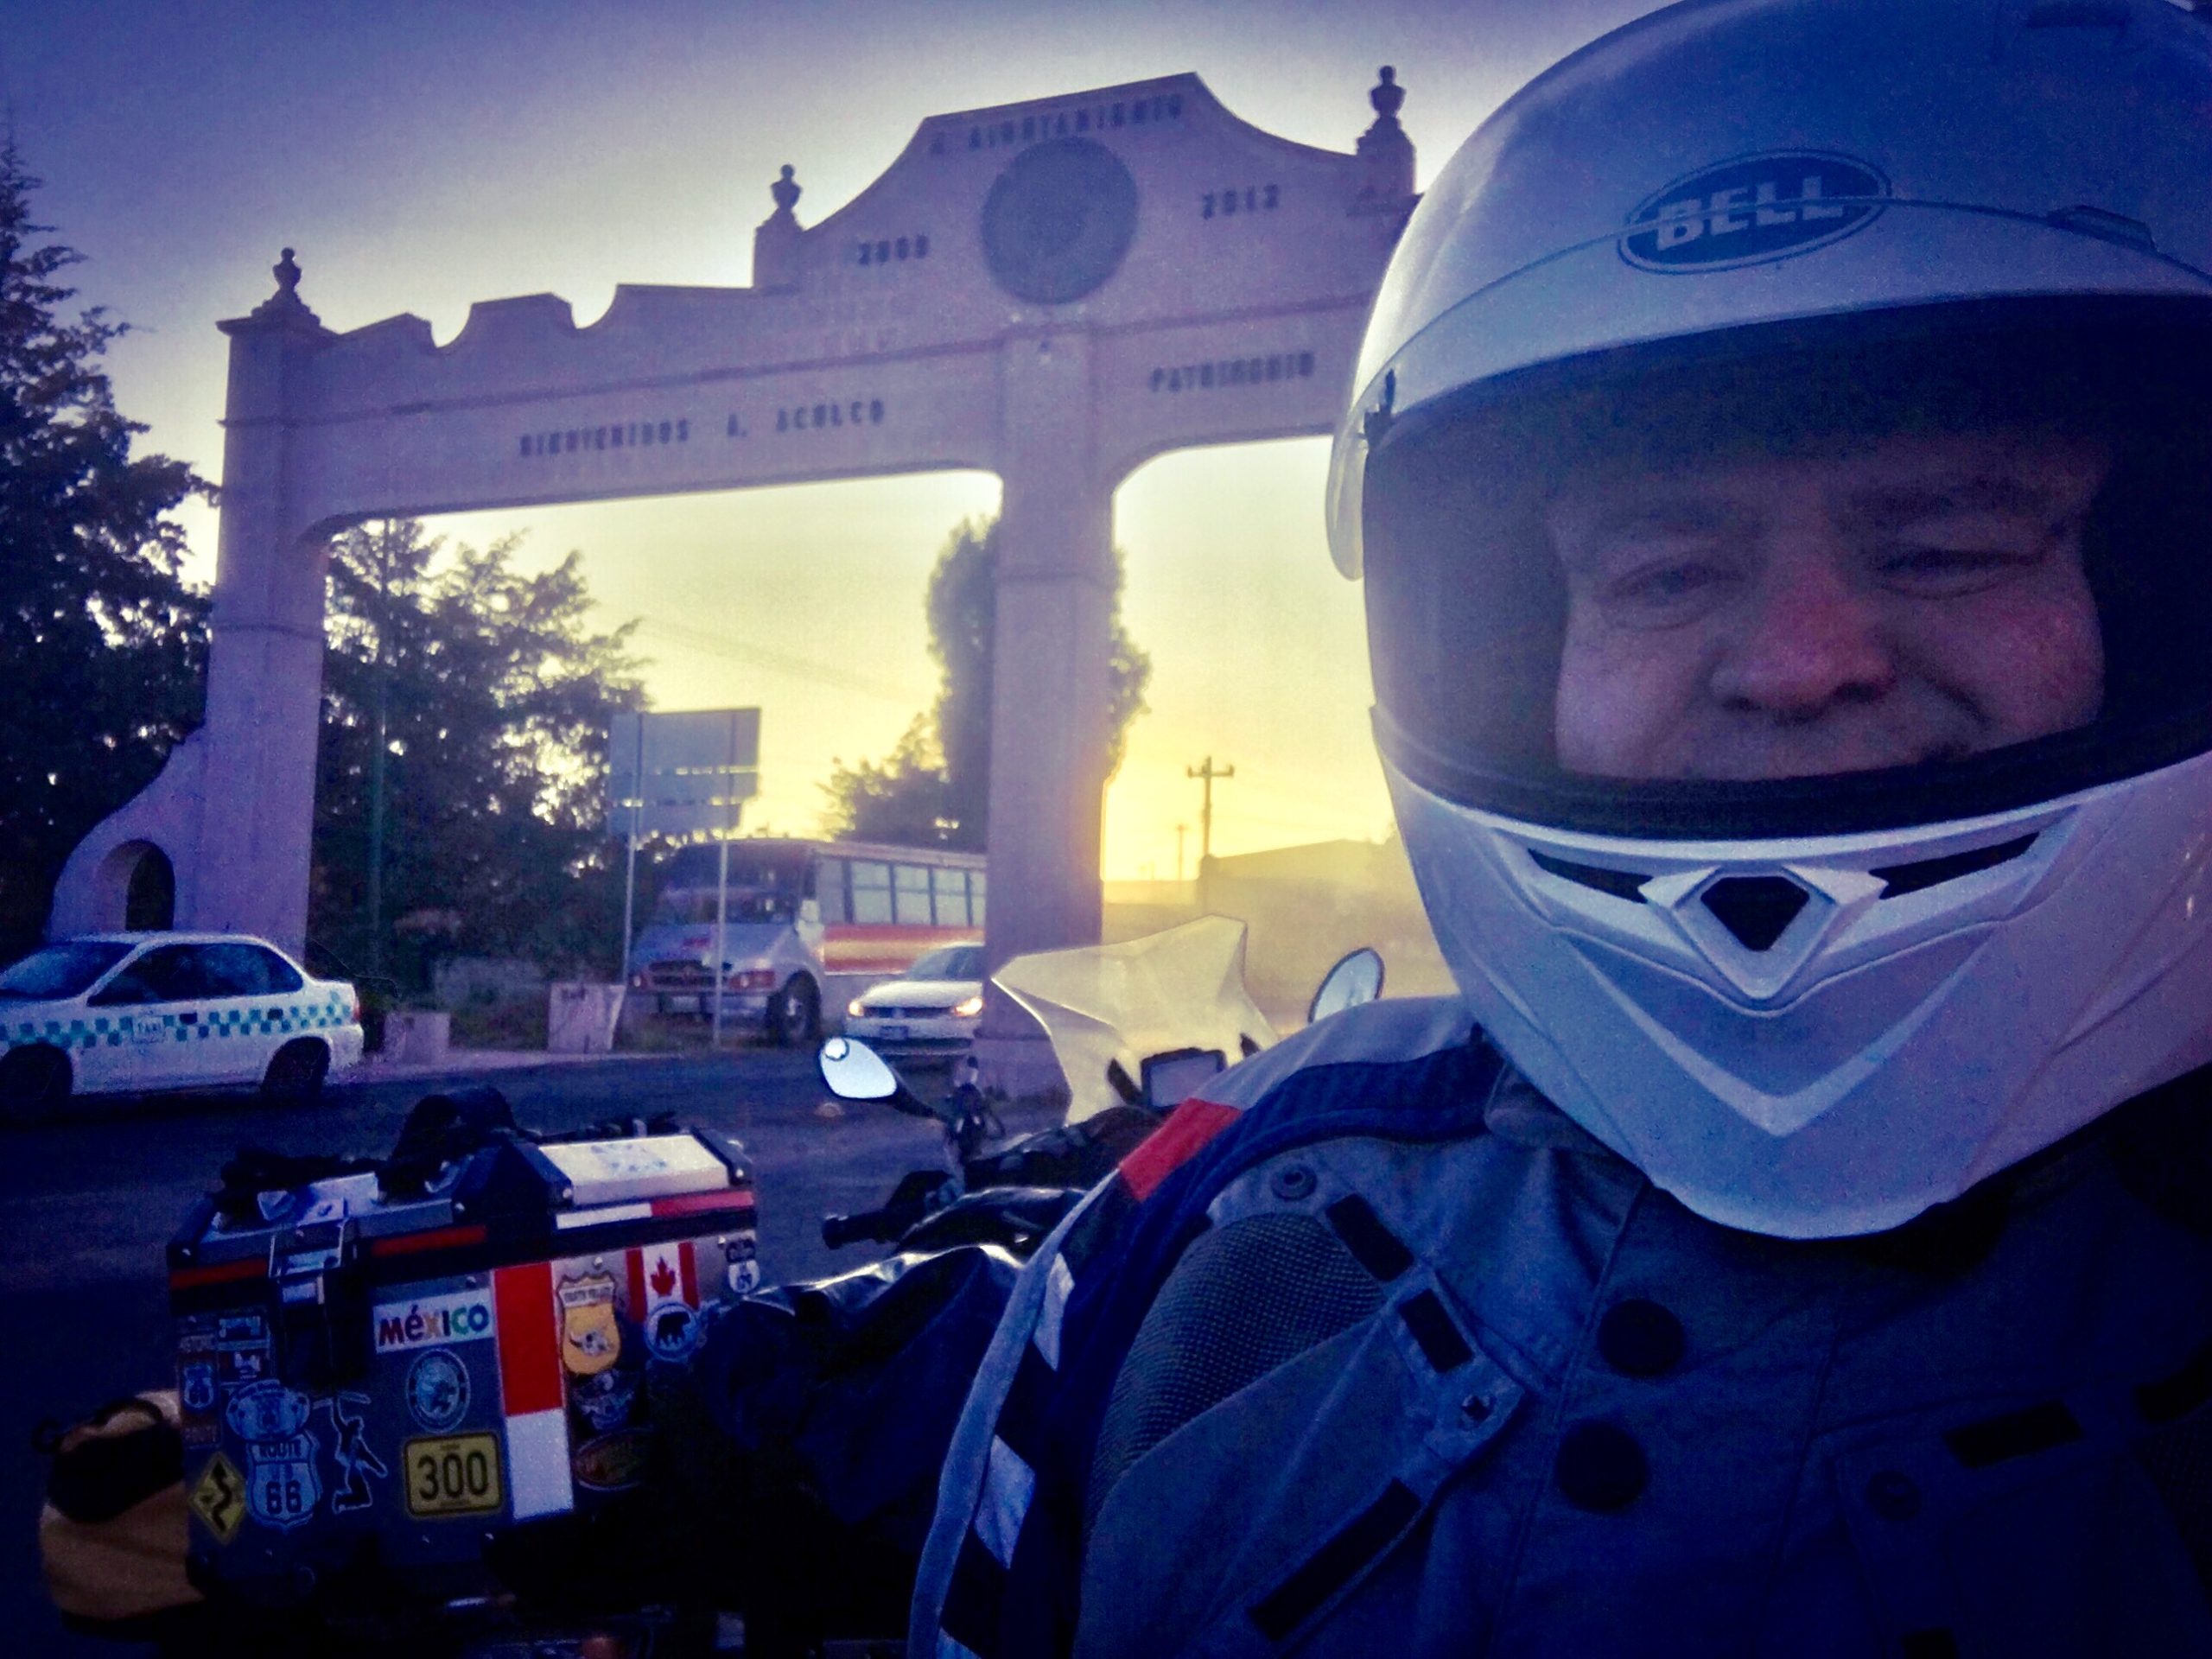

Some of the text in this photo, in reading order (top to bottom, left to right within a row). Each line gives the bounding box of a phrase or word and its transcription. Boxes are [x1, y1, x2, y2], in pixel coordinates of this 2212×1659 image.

[1656, 175, 1843, 251] BELL
[265, 1479, 302, 1515] 66
[417, 1450, 490, 1502] 300
